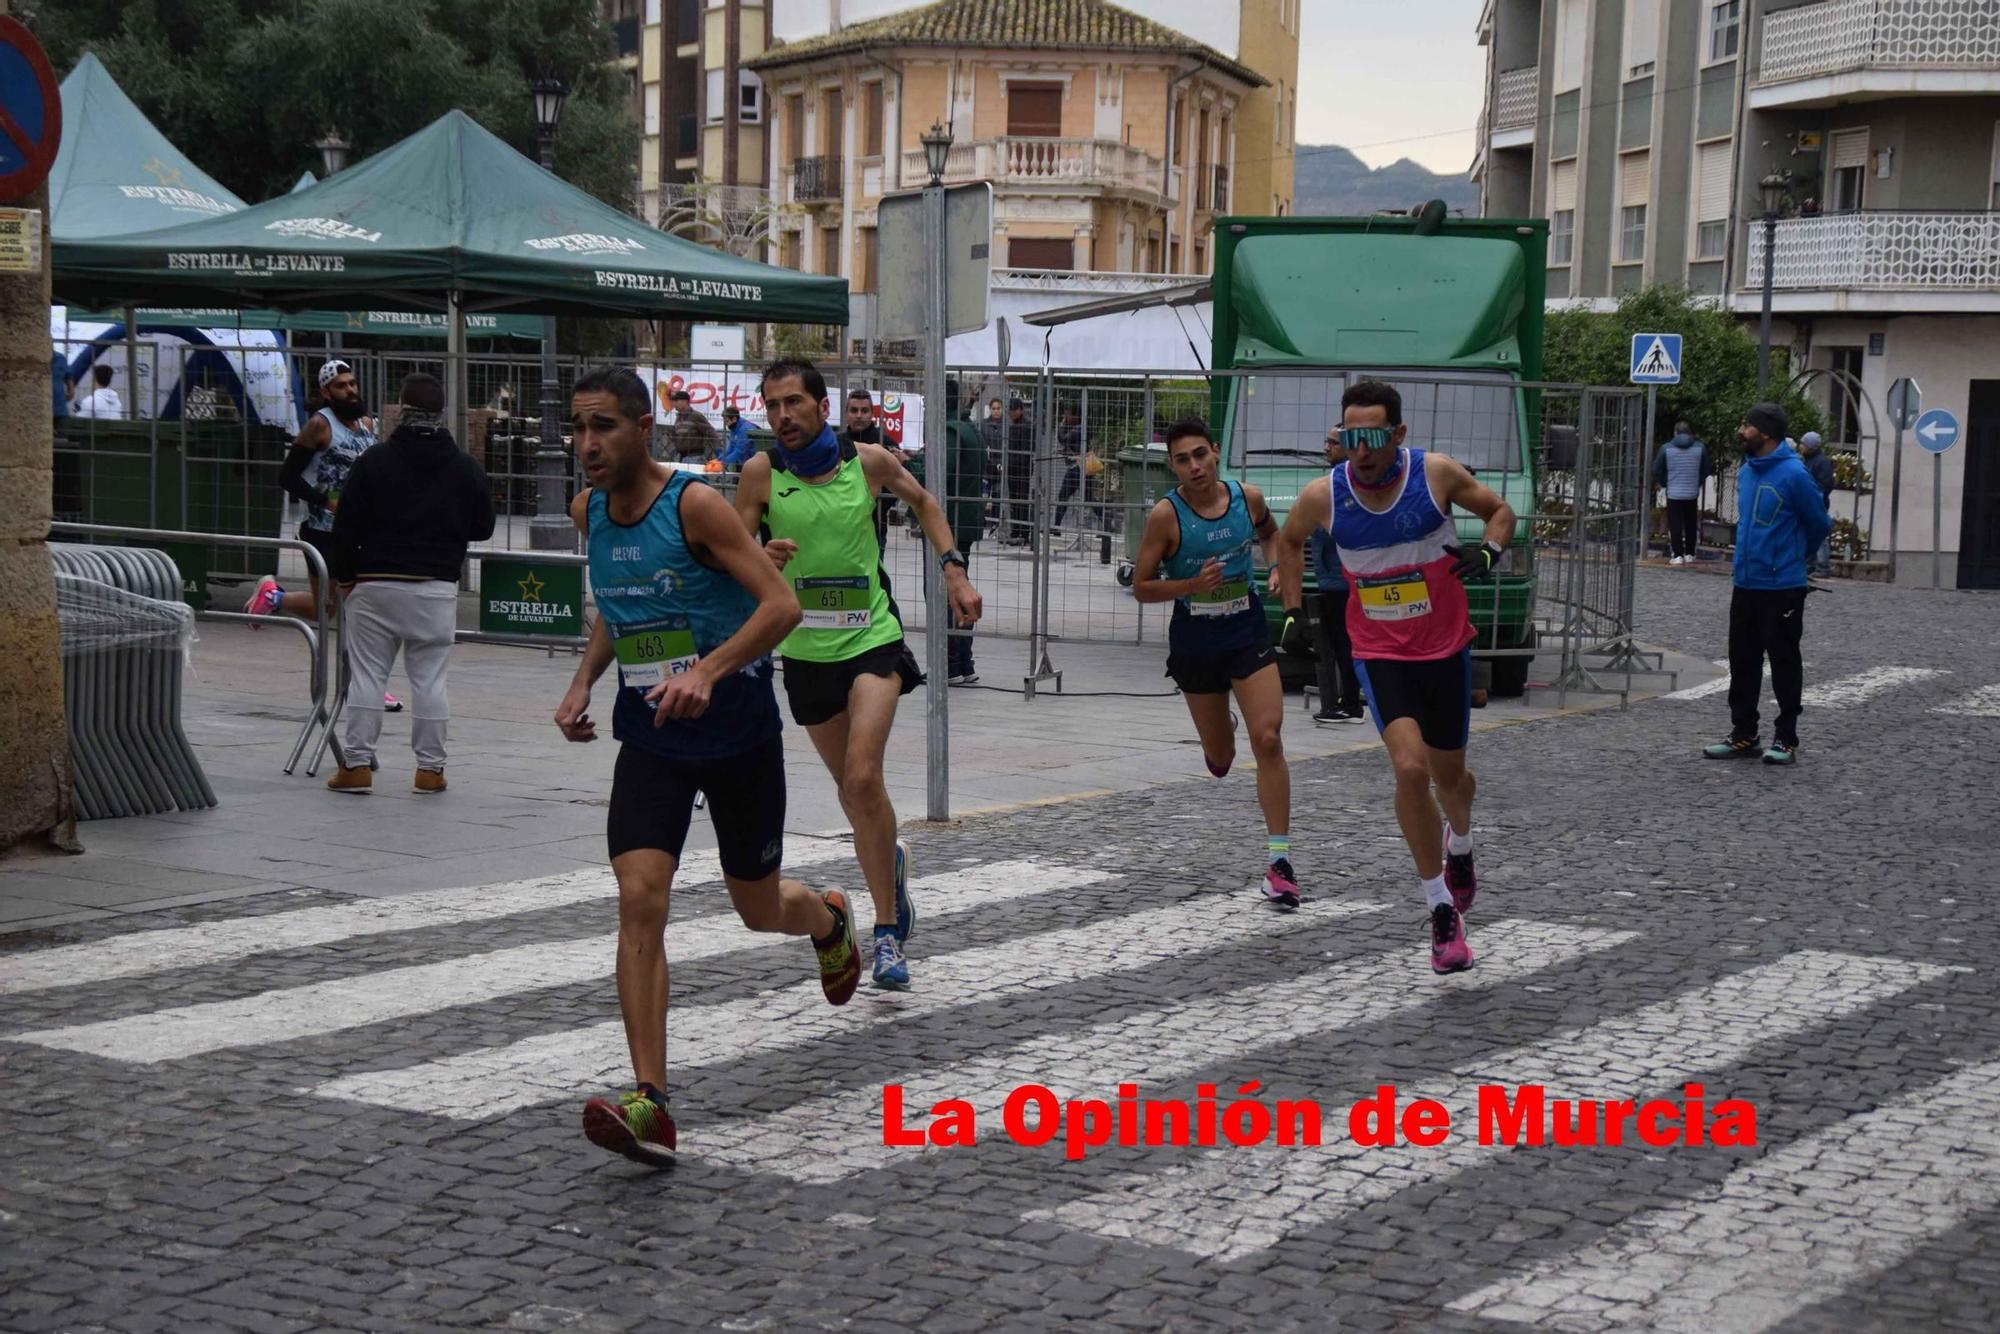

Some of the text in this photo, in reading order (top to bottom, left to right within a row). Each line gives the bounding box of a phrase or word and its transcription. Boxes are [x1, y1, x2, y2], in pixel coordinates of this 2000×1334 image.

[523, 232, 646, 250] ESTRELLA
[168, 253, 251, 270] ESTRELLA
[266, 254, 345, 272] LEVANTE
[594, 270, 762, 301] ESTRELLA DE LEVANTE
[368, 311, 432, 325] ESTRELLA
[821, 590, 844, 607] 651
[1384, 586, 1400, 601] 45
[489, 600, 573, 617] ESTRELLA
[519, 614, 554, 624] LEVANTE
[636, 635, 665, 659] 663
